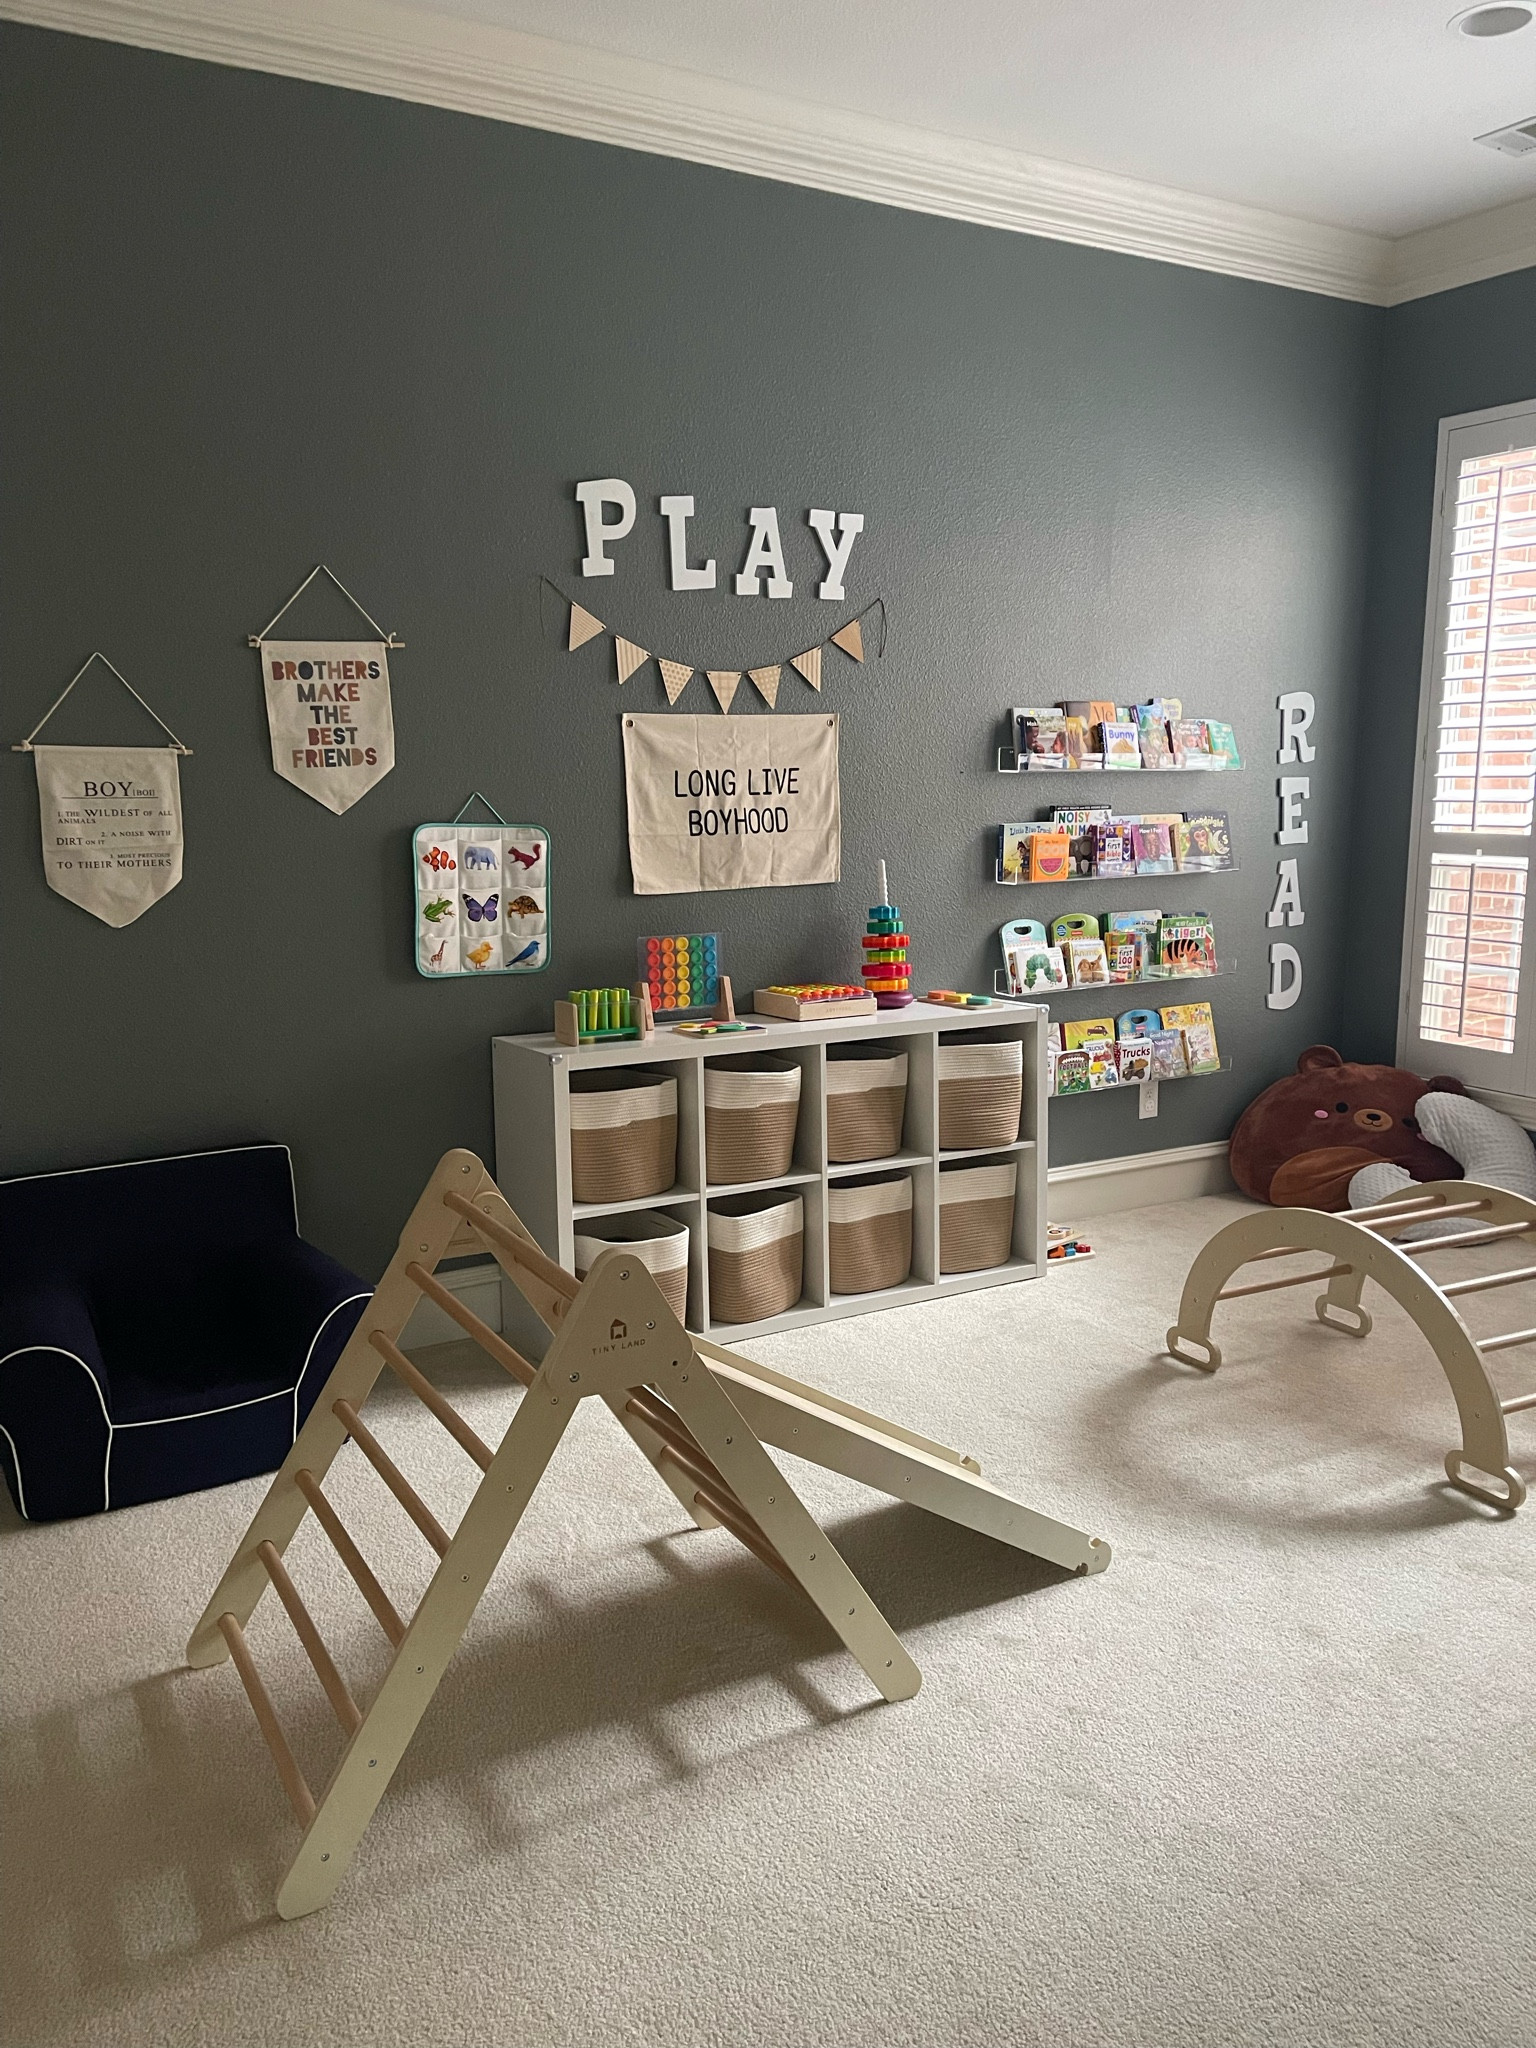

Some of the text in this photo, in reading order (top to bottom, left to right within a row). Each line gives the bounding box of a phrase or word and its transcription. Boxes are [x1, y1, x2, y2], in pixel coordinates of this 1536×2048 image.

[576, 478, 865, 600] PLAY
[271, 660, 380, 681] BROTHERS
[297, 683, 361, 702] MAKE
[310, 705, 352, 724] THE
[307, 727, 358, 746] BEST
[1108, 729, 1135, 741] Bunny
[292, 747, 377, 768] FRIENDS
[83, 781, 133, 797] BOY
[673, 767, 800, 799] LONG LIVE
[84, 808, 140, 817] WILDEST
[1058, 811, 1090, 824] NOISY
[688, 806, 789, 836] BOYHOOD
[56, 837, 84, 845] DIRT
[1107, 842, 1121, 850] first
[1266, 691, 1316, 1010] READ
[57, 858, 172, 869] TO THEIR MOTHERS
[1174, 927, 1204, 939] tiger!
[1118, 957, 1132, 965] 100
[1119, 949, 1132, 957] first
[1122, 1046, 1151, 1058] Trucks
[592, 1339, 646, 1356] TINY LAND
